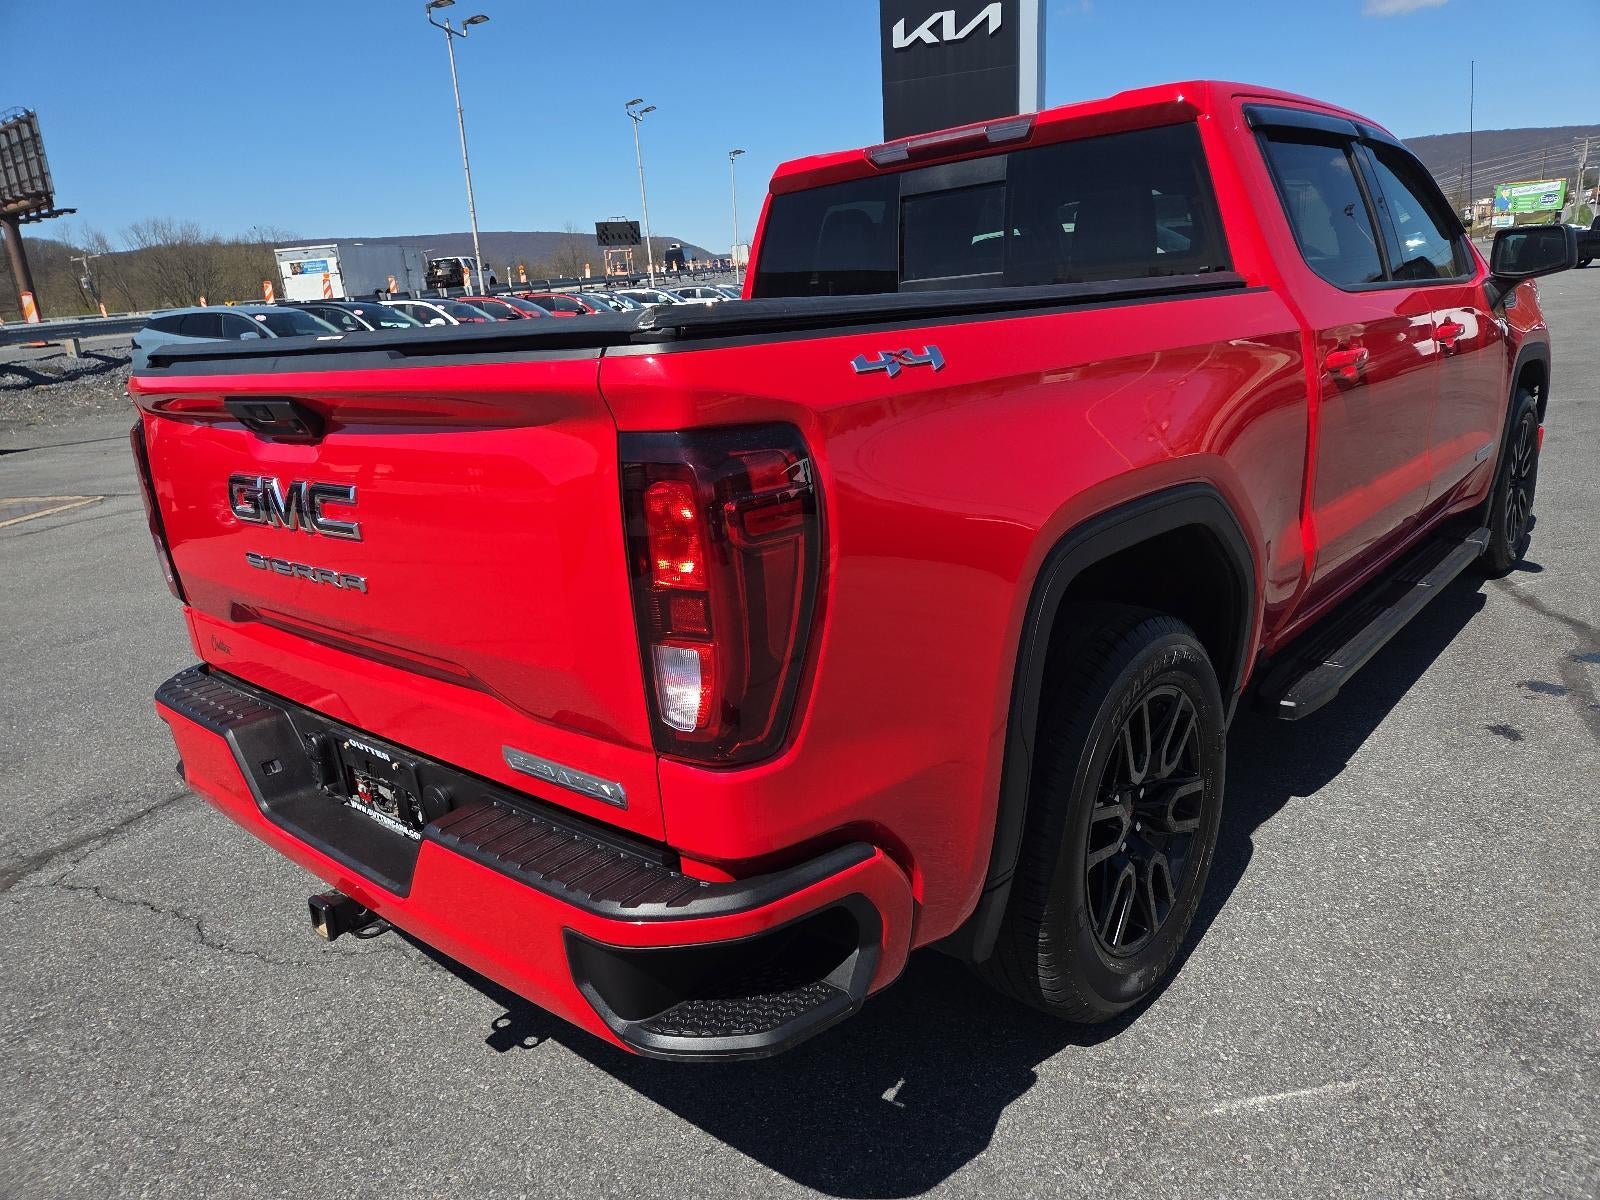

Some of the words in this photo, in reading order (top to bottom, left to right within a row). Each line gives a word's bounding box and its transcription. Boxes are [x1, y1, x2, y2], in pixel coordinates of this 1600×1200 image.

[893, 2, 1002, 49] KIA
[228, 474, 363, 541] GMC
[245, 551, 368, 594] SIERRA
[348, 739, 391, 762] OUTTEN
